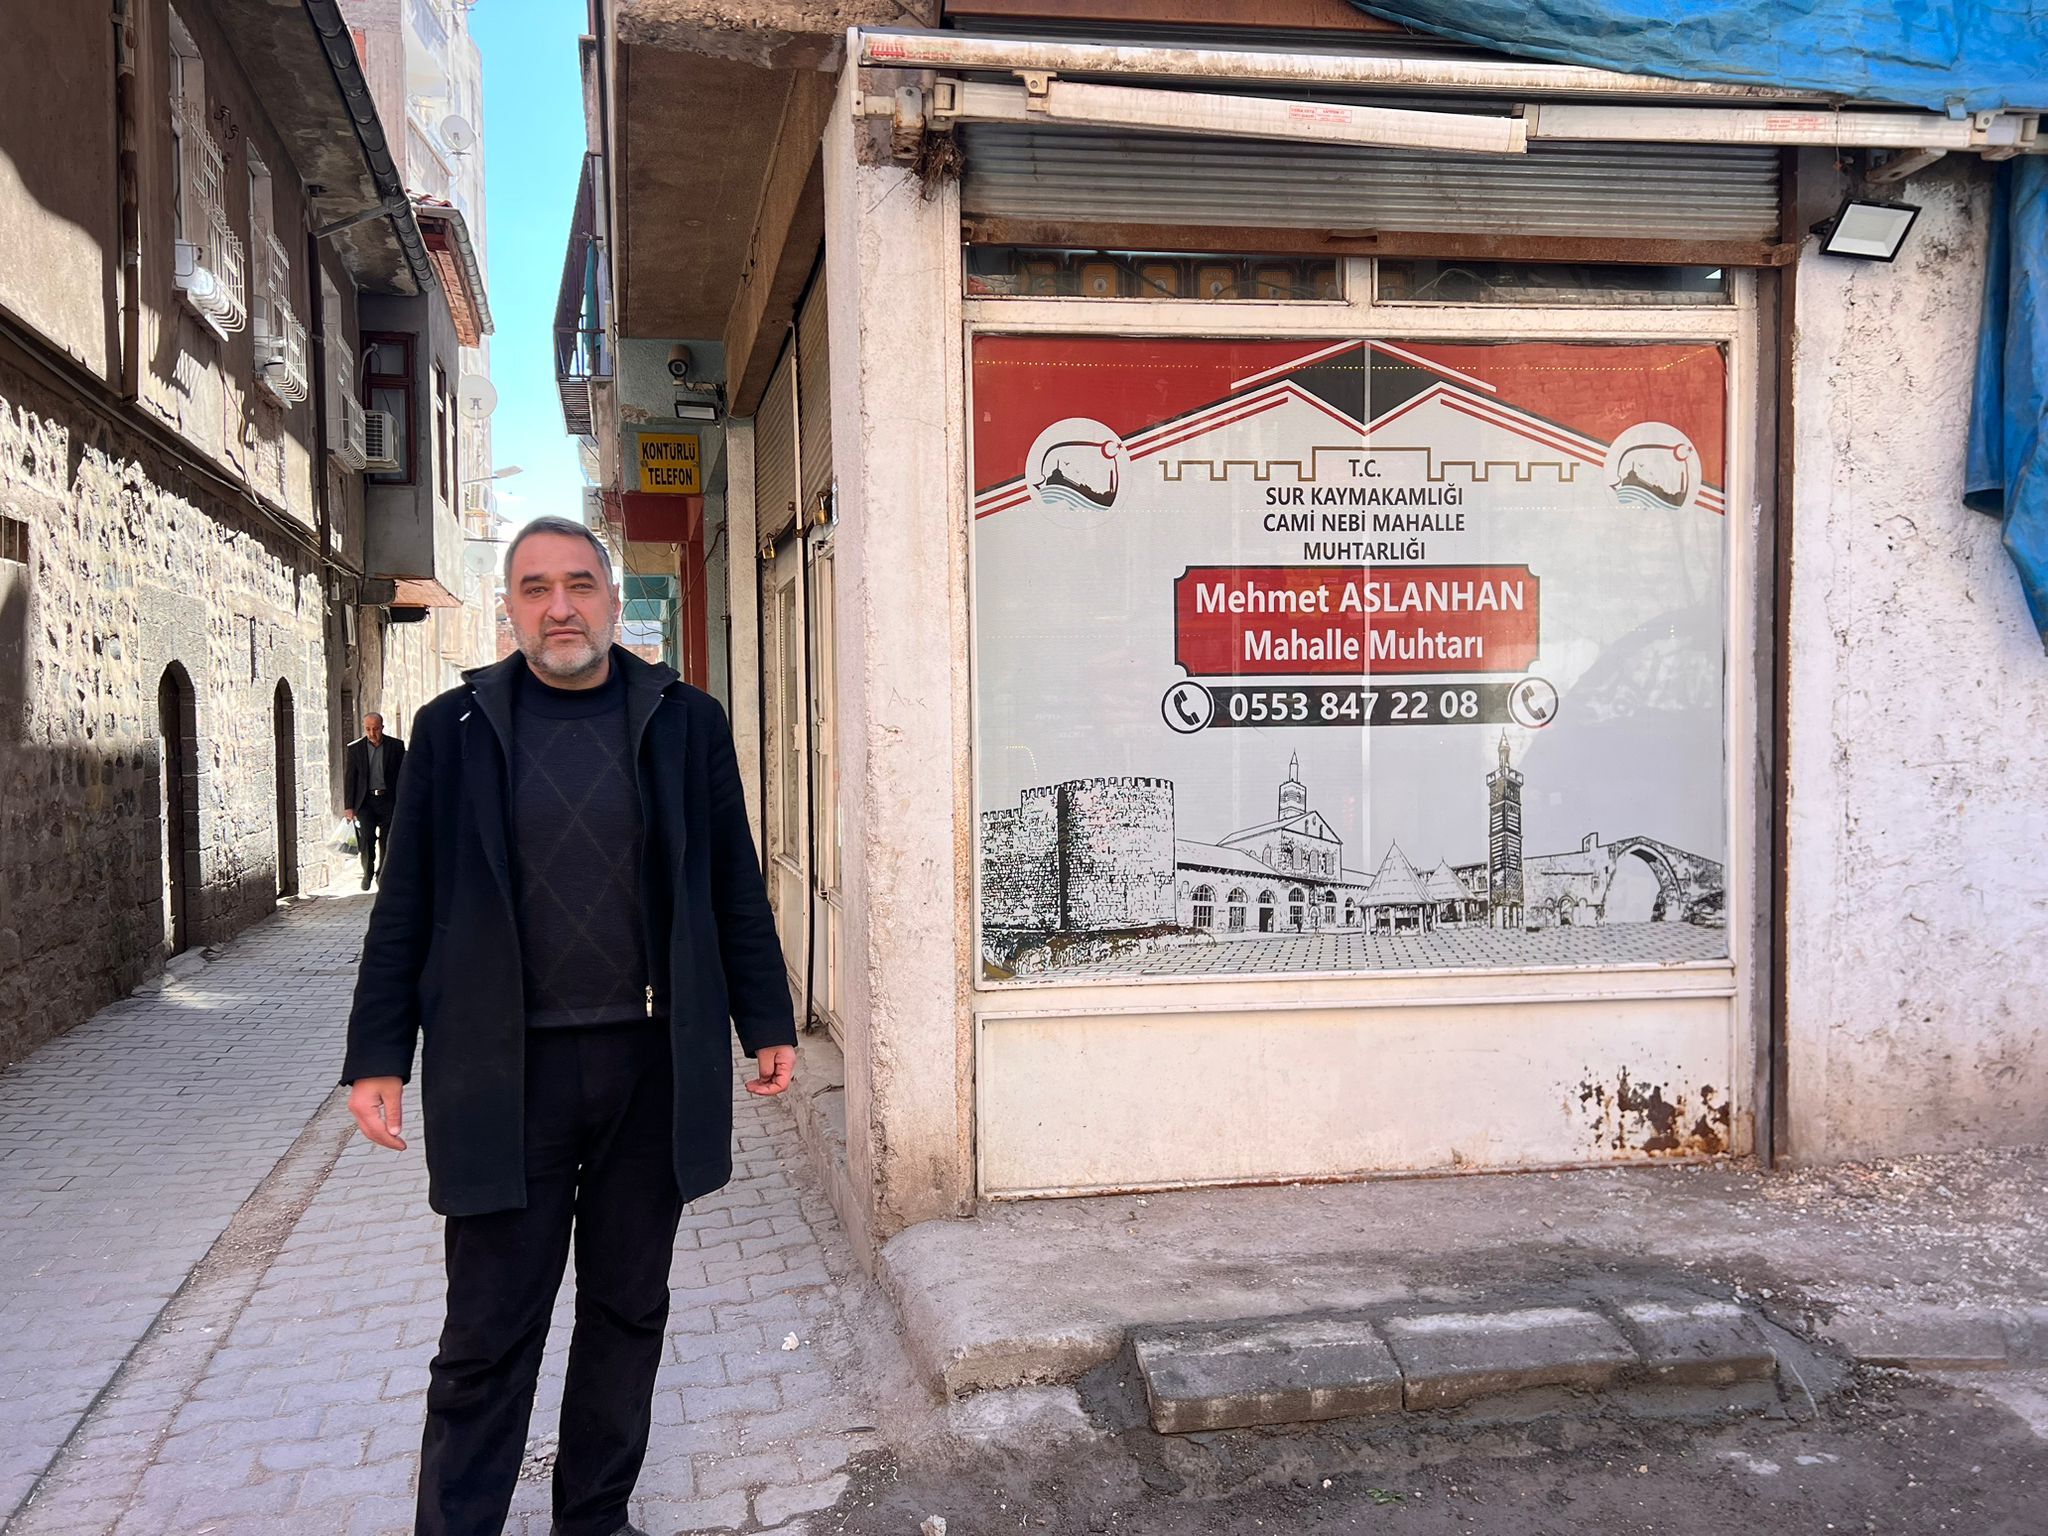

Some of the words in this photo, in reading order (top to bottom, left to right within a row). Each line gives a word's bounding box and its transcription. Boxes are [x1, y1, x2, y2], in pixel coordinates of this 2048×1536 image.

[642, 442, 696, 460] KONTÜRLÜ
[648, 467, 693, 486] TELEFON
[1348, 459, 1382, 478] T.C.
[1265, 487, 1305, 506] SUR
[1311, 483, 1463, 506] KAYMAKAMLIĞI
[1263, 510, 1315, 532] CAMİ
[1322, 510, 1366, 532] NEBİ
[1373, 513, 1465, 532] MAHALLE
[1303, 537, 1425, 561] MUHTARLIĞI
[1196, 581, 1330, 614] Mehmet
[1339, 580, 1524, 613] ASLANHAN
[1244, 628, 1360, 662] Mahalle
[1369, 627, 1483, 660] Muhtarı
[1229, 692, 1309, 722] 0553
[1319, 691, 1379, 720] 847
[1390, 691, 1429, 719] 22
[1439, 690, 1479, 718] 08
